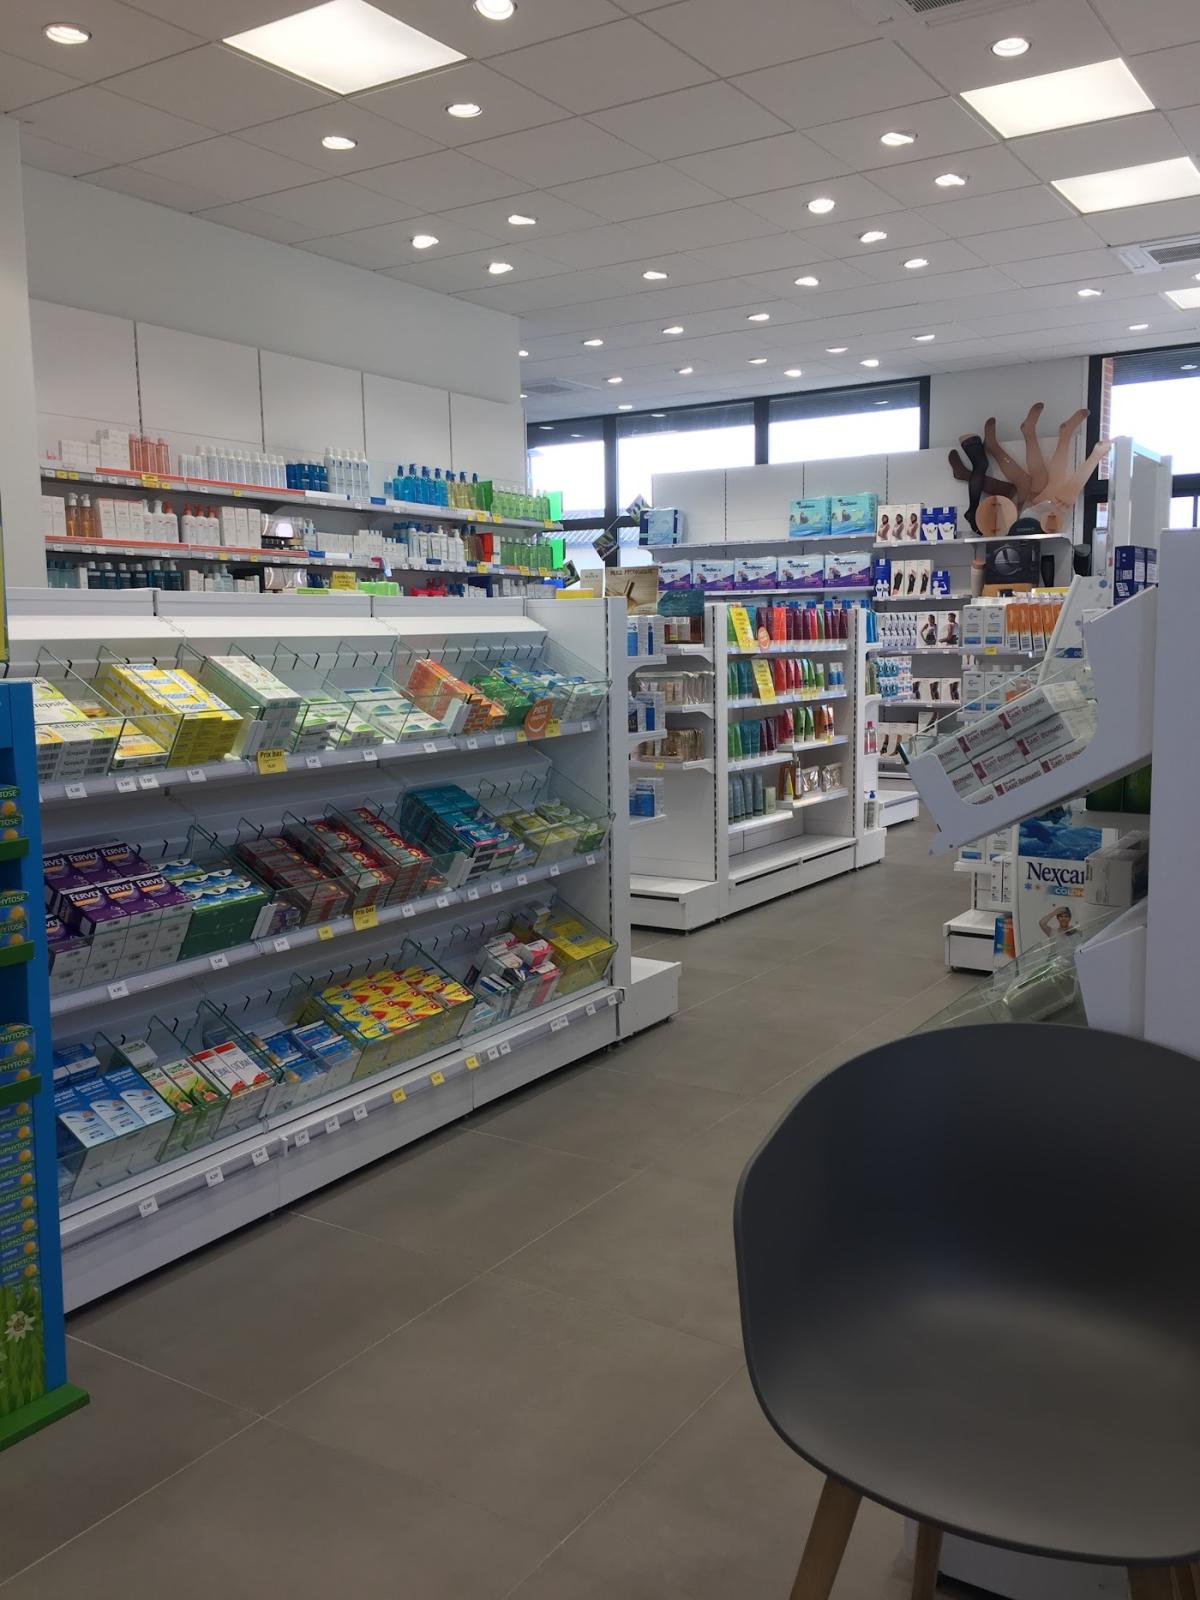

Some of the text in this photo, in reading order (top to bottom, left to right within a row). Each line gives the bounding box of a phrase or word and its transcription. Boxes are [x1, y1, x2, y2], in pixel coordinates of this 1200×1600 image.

[101, 845, 131, 857] FERVEX
[44, 856, 66, 867] RVEX
[68, 852, 101, 863] FERVEX
[104, 882, 136, 895] FERVEX
[136, 877, 168, 889] FERVEX
[69, 890, 103, 902] FERVEX
[46, 918, 60, 928] VEX
